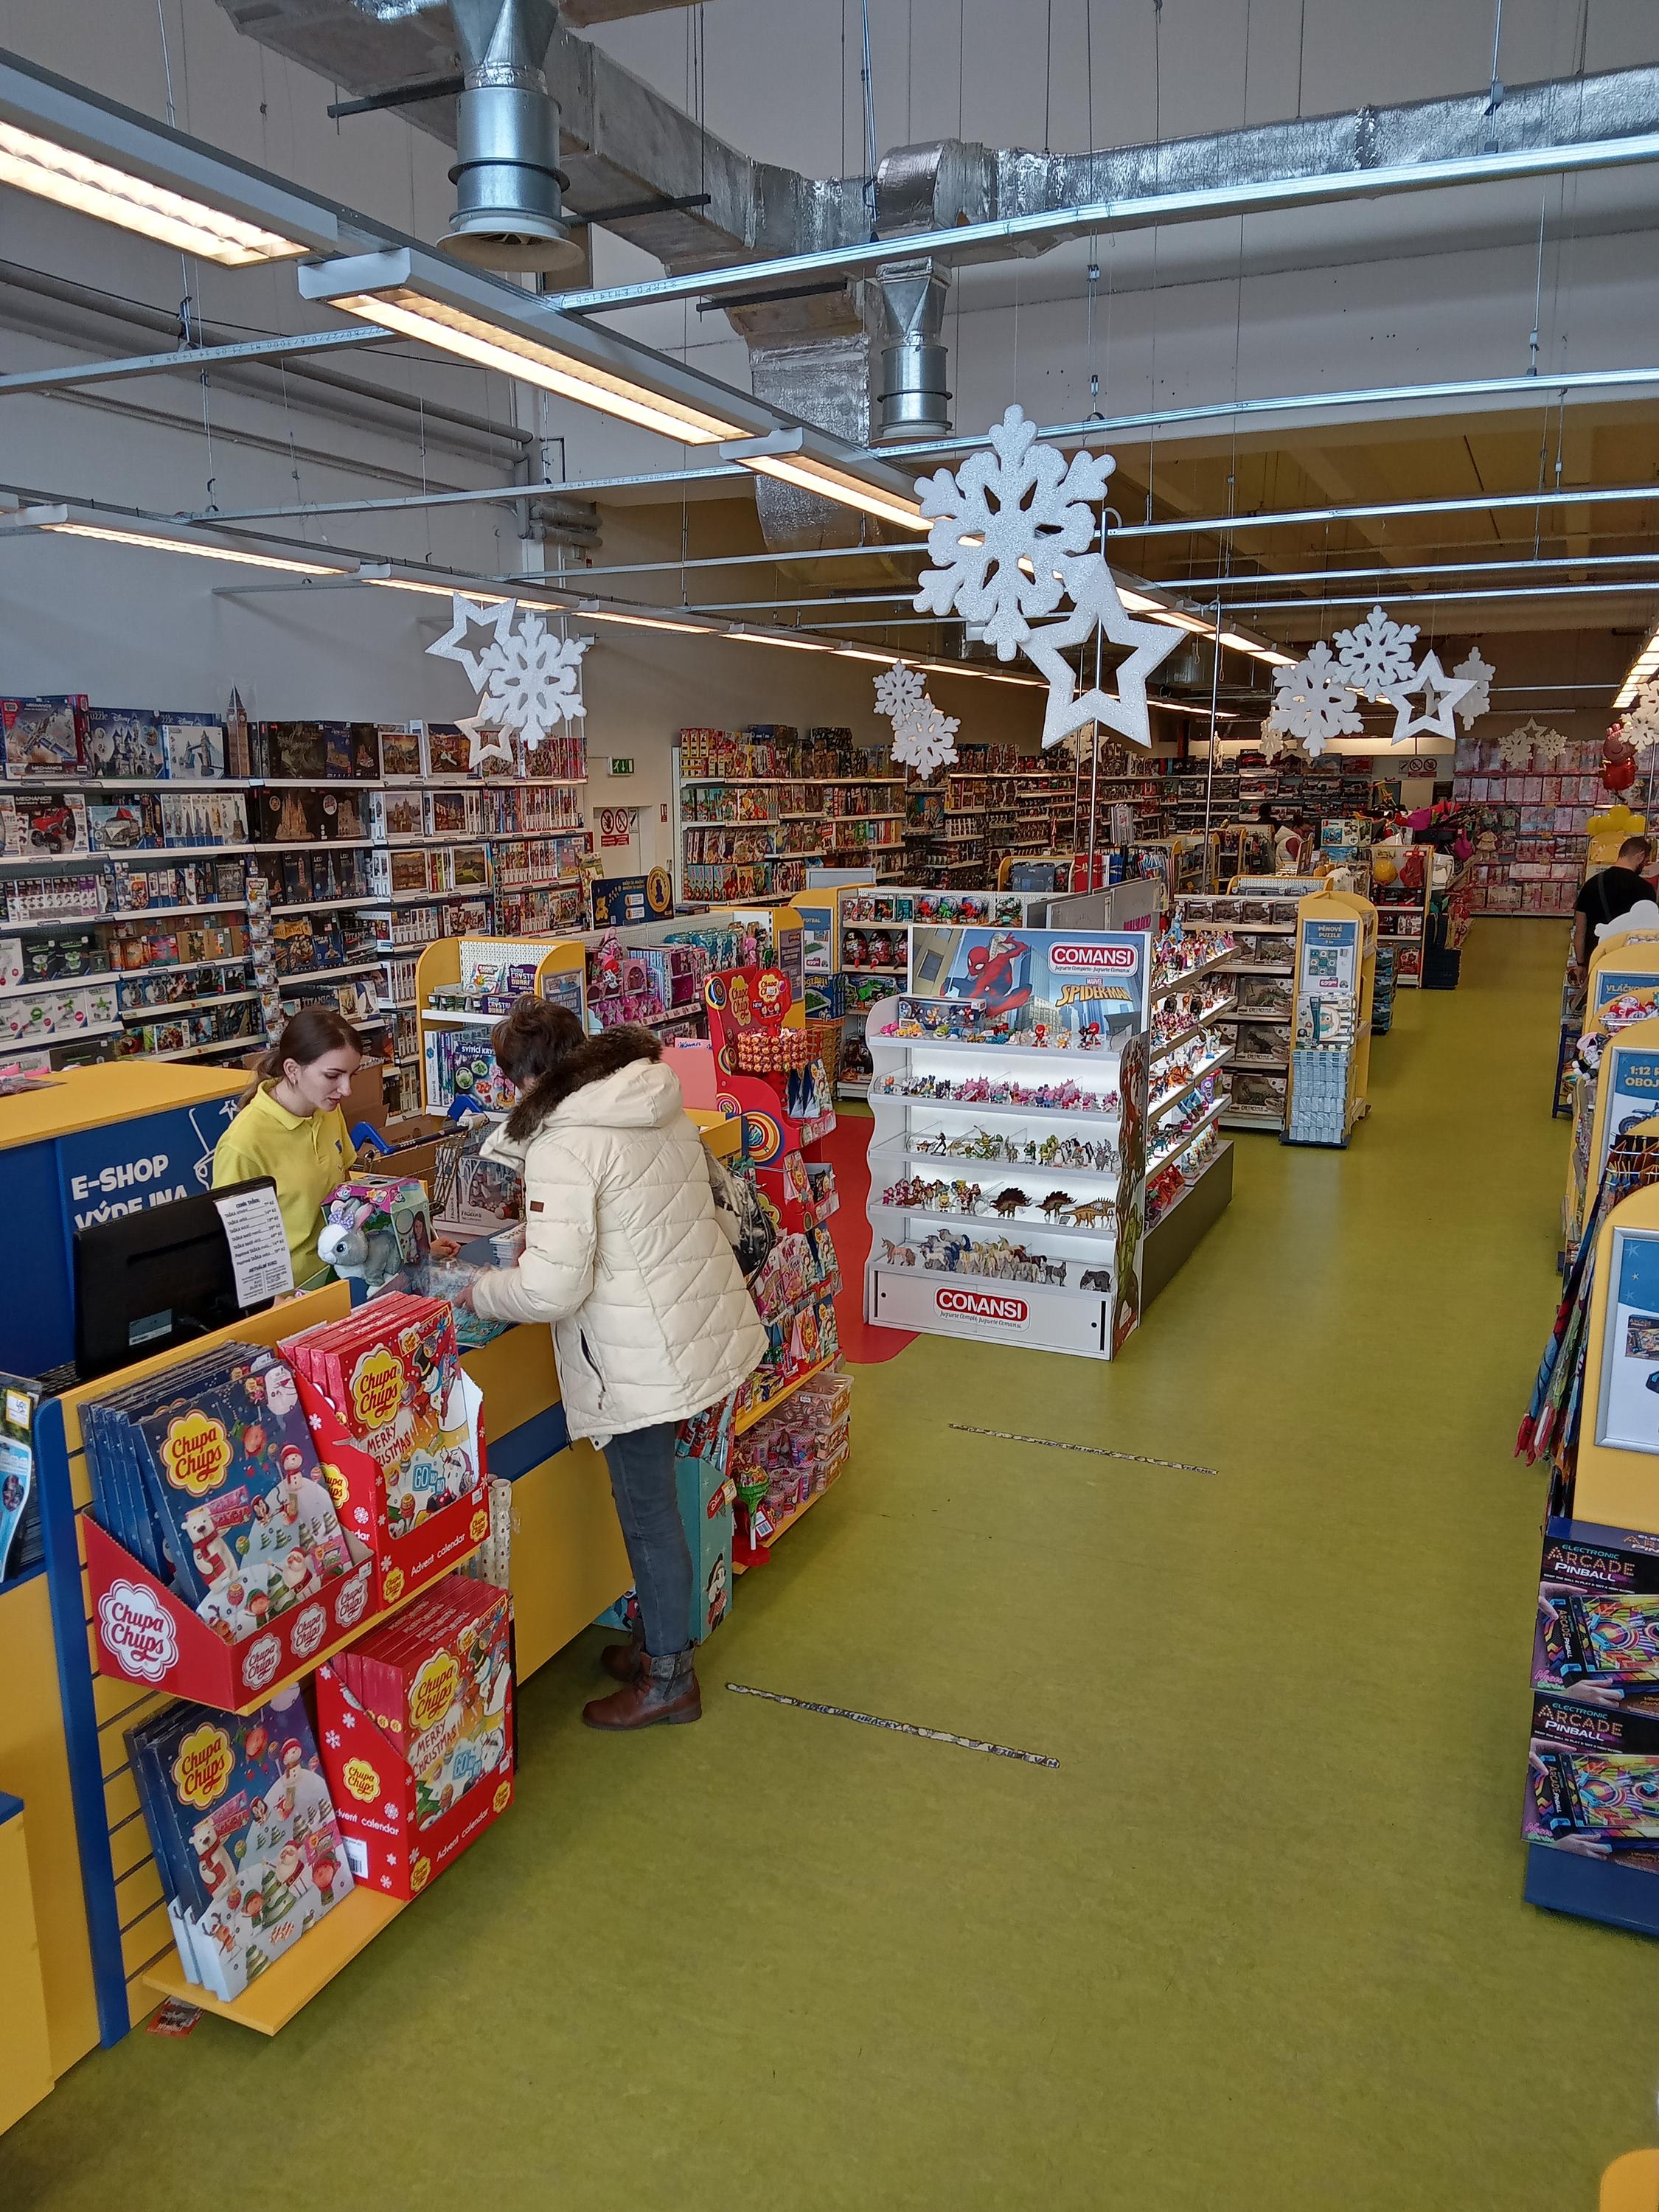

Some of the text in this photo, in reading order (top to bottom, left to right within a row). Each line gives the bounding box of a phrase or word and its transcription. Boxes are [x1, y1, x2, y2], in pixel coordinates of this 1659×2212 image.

[90, 712, 108, 720] uzzle
[344, 931, 369, 940] TITANIC
[1054, 948, 1131, 965] COMANSI
[1055, 984, 1133, 1007] SPIDER-MAN
[1630, 1065, 1651, 1076] 1:12
[71, 1154, 169, 1200] E-SHOP
[939, 1291, 1022, 1319] COMANSI
[361, 1365, 397, 1394] Chupa
[360, 1382, 398, 1418] Chups
[171, 1427, 218, 1460] Chupa
[368, 1423, 397, 1452] MERRY
[375, 1432, 412, 1468] RISTMAS
[175, 1444, 222, 1483] Chups
[411, 1533, 467, 1577] Advent calendar
[1547, 1546, 1635, 1576] ARCADE
[1562, 1544, 1620, 1559] ELECTRONIC
[1554, 1562, 1615, 1582] PINBALL
[339, 1597, 363, 1618] Chups
[341, 1587, 364, 1604] Chupa
[111, 1602, 164, 1632] Chupa
[296, 1615, 321, 1635] Chupa
[111, 1623, 164, 1663] Chups
[295, 1624, 321, 1647] Chups
[247, 1654, 276, 1679] Chups
[249, 1644, 276, 1666] Chupa
[417, 1665, 453, 1699] Chupa
[414, 1683, 453, 1719] Chups
[1552, 1703, 1608, 1719] ELECTRONIC
[1537, 1705, 1624, 1737] ARCADE
[1545, 1720, 1604, 1742] PINBALL
[413, 1725, 458, 1778] CHRISTMAS
[415, 1719, 447, 1757] MERRY
[181, 1737, 222, 1775] Chupa
[184, 1755, 225, 1795] Chups
[347, 1775, 375, 1795] Chups
[348, 1766, 375, 1783] Chupa
[335, 1808, 400, 1837] dvent calendar
[437, 1808, 490, 1863] Advent calendar
